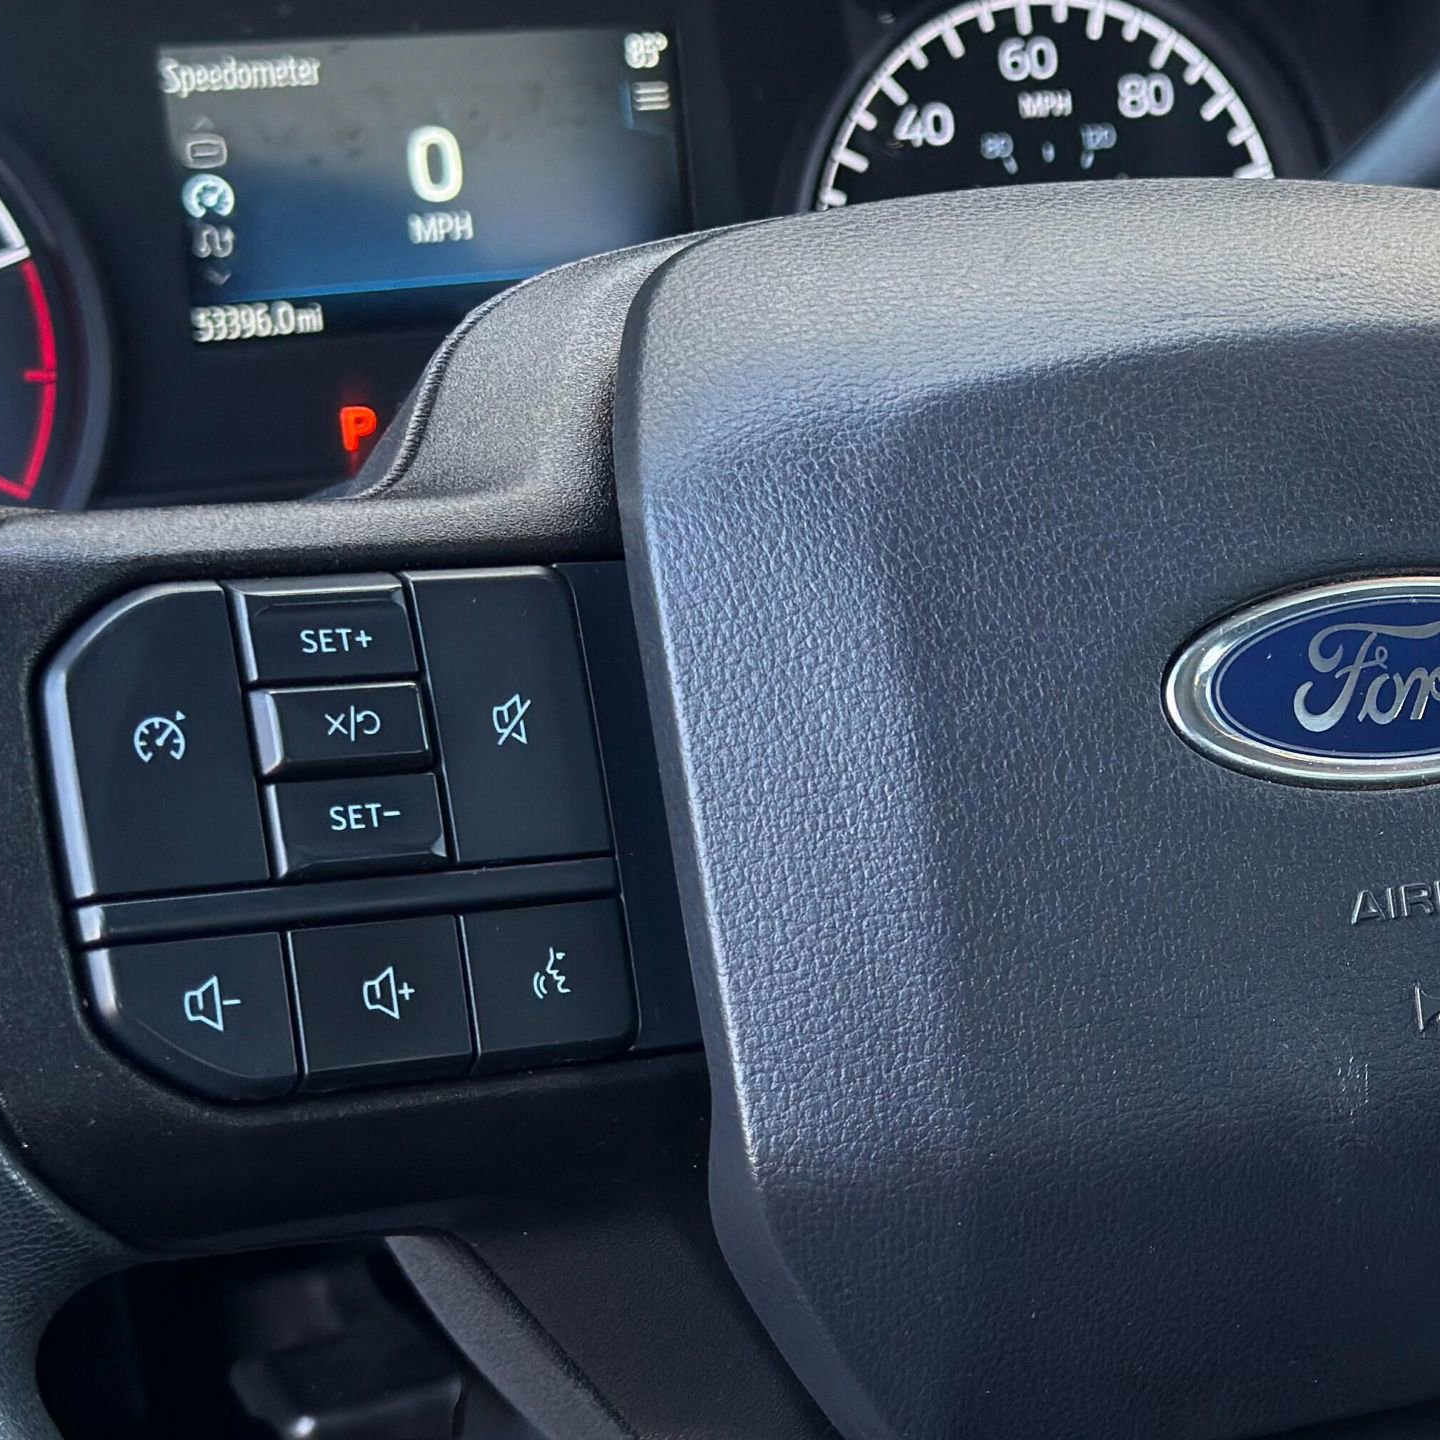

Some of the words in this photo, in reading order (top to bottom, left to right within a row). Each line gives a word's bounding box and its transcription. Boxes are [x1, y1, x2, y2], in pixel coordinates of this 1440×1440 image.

[160, 56, 321, 98] Speedometer
[997, 35, 1059, 81] 60
[1117, 72, 1175, 118] 80
[893, 102, 955, 147] 40
[408, 125, 463, 203] 0
[408, 210, 474, 244] MPH
[339, 405, 378, 452] P
[299, 628, 373, 654] SET+
